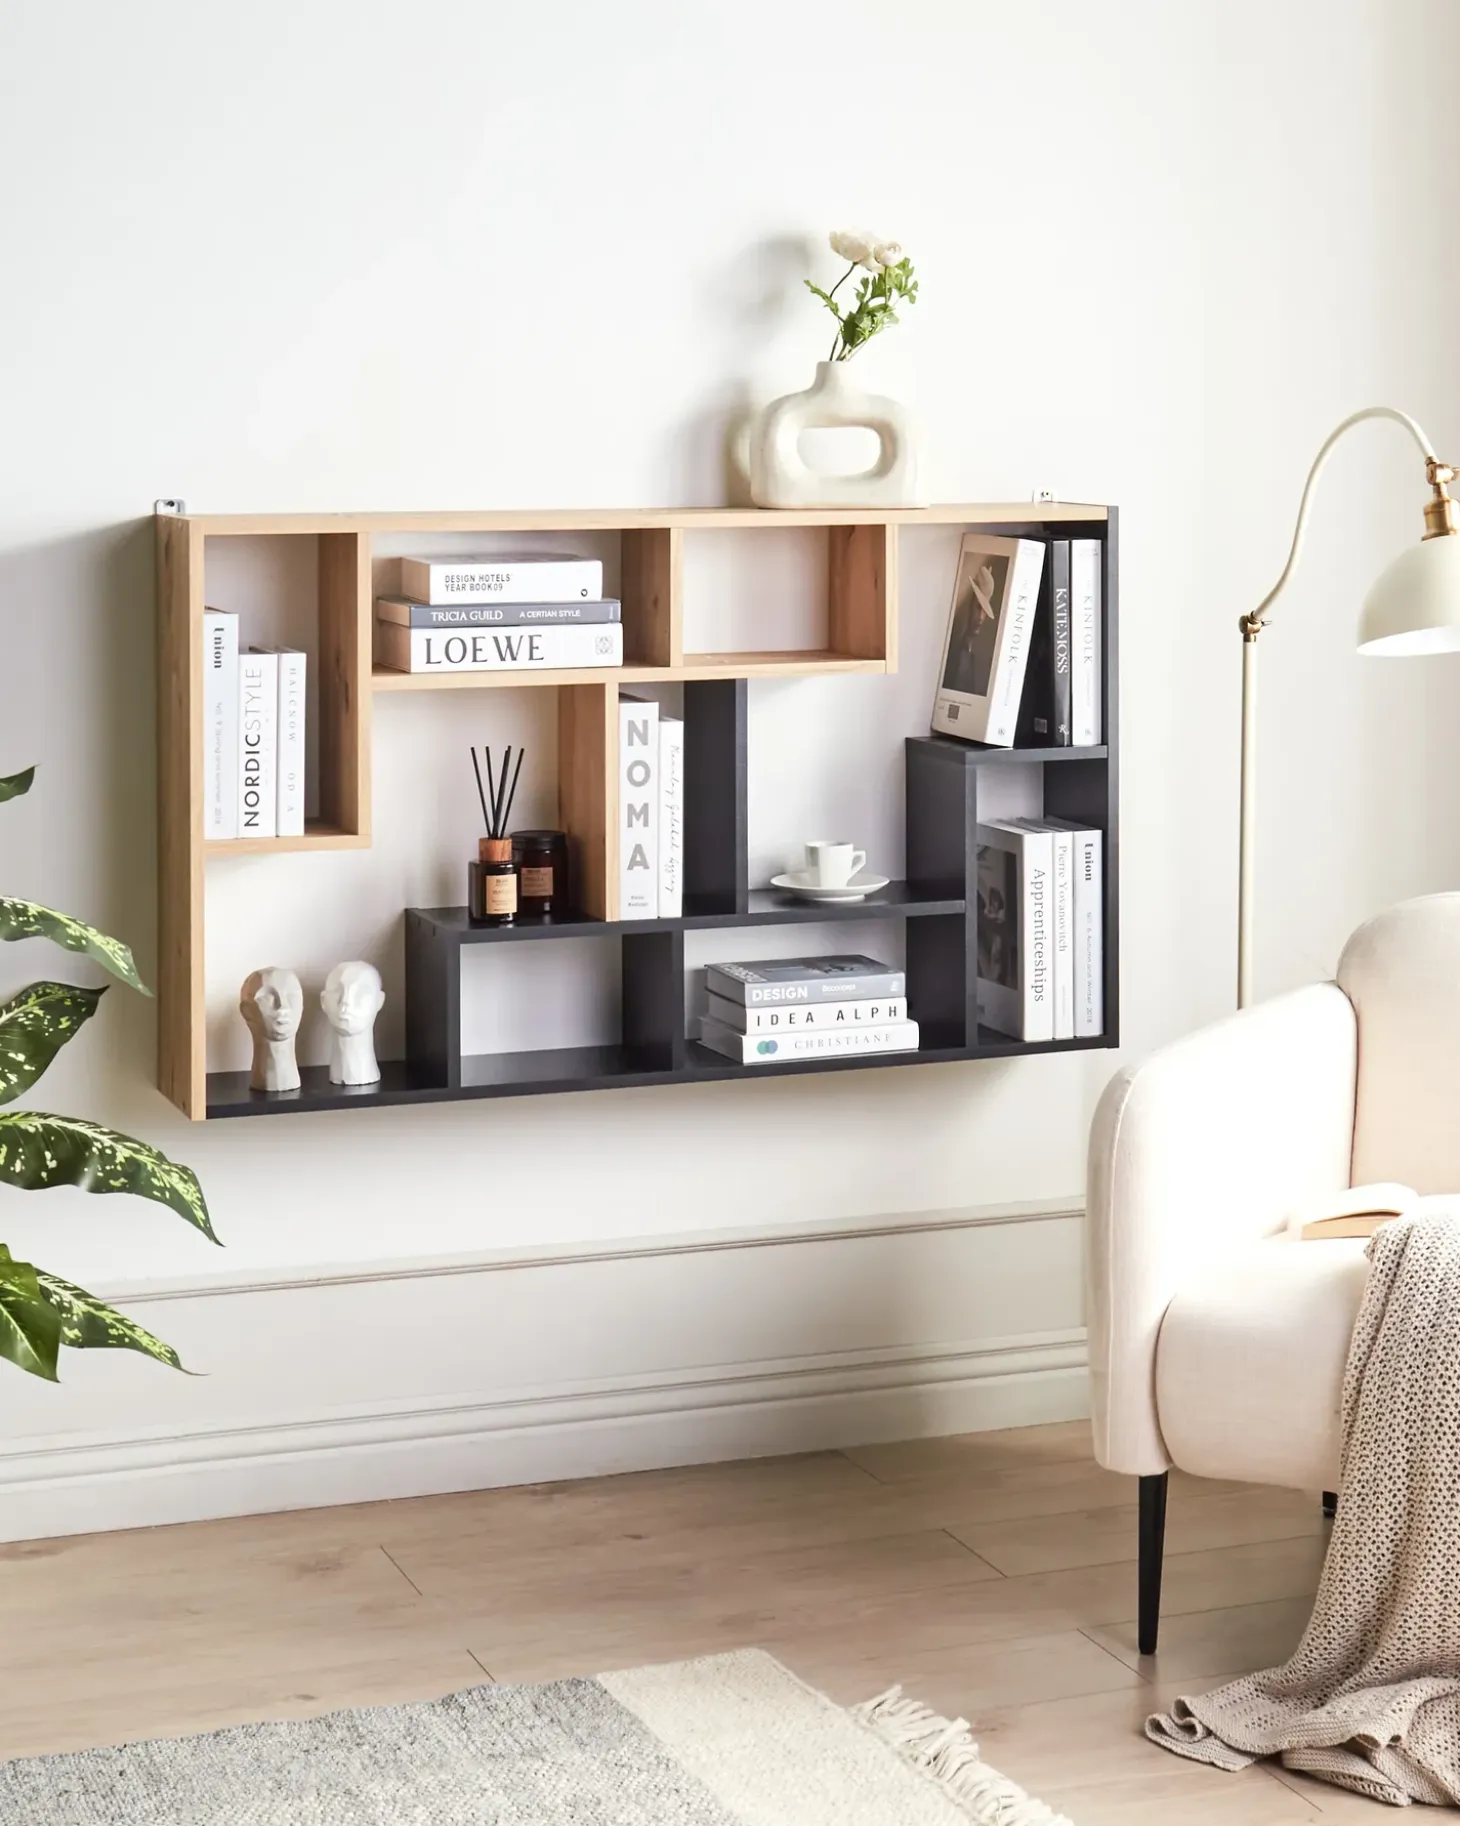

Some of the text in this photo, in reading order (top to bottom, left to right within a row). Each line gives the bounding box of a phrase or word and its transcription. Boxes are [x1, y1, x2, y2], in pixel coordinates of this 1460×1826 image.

[445, 573, 511, 583] DESIGN HOTELS
[445, 583, 467, 592] YEAR
[430, 611, 468, 622] TRICIA
[469, 610, 504, 621] GUILD
[558, 609, 581, 617] STYLE
[1008, 594, 1028, 664] KINFOLK
[1083, 595, 1093, 664] KINFOLK
[213, 627, 225, 669] Union
[425, 634, 545, 665] LOEWE
[626, 719, 651, 871] NOMA
[1084, 843, 1094, 881] Union
[1058, 845, 1068, 952] Pierre Yovanovitch
[1030, 868, 1047, 1002] Apprenticeships
[752, 986, 808, 1001] DESIGN
[756, 1005, 898, 1027] IDEA ALPH
[794, 1032, 892, 1050] CHRISTIANE
